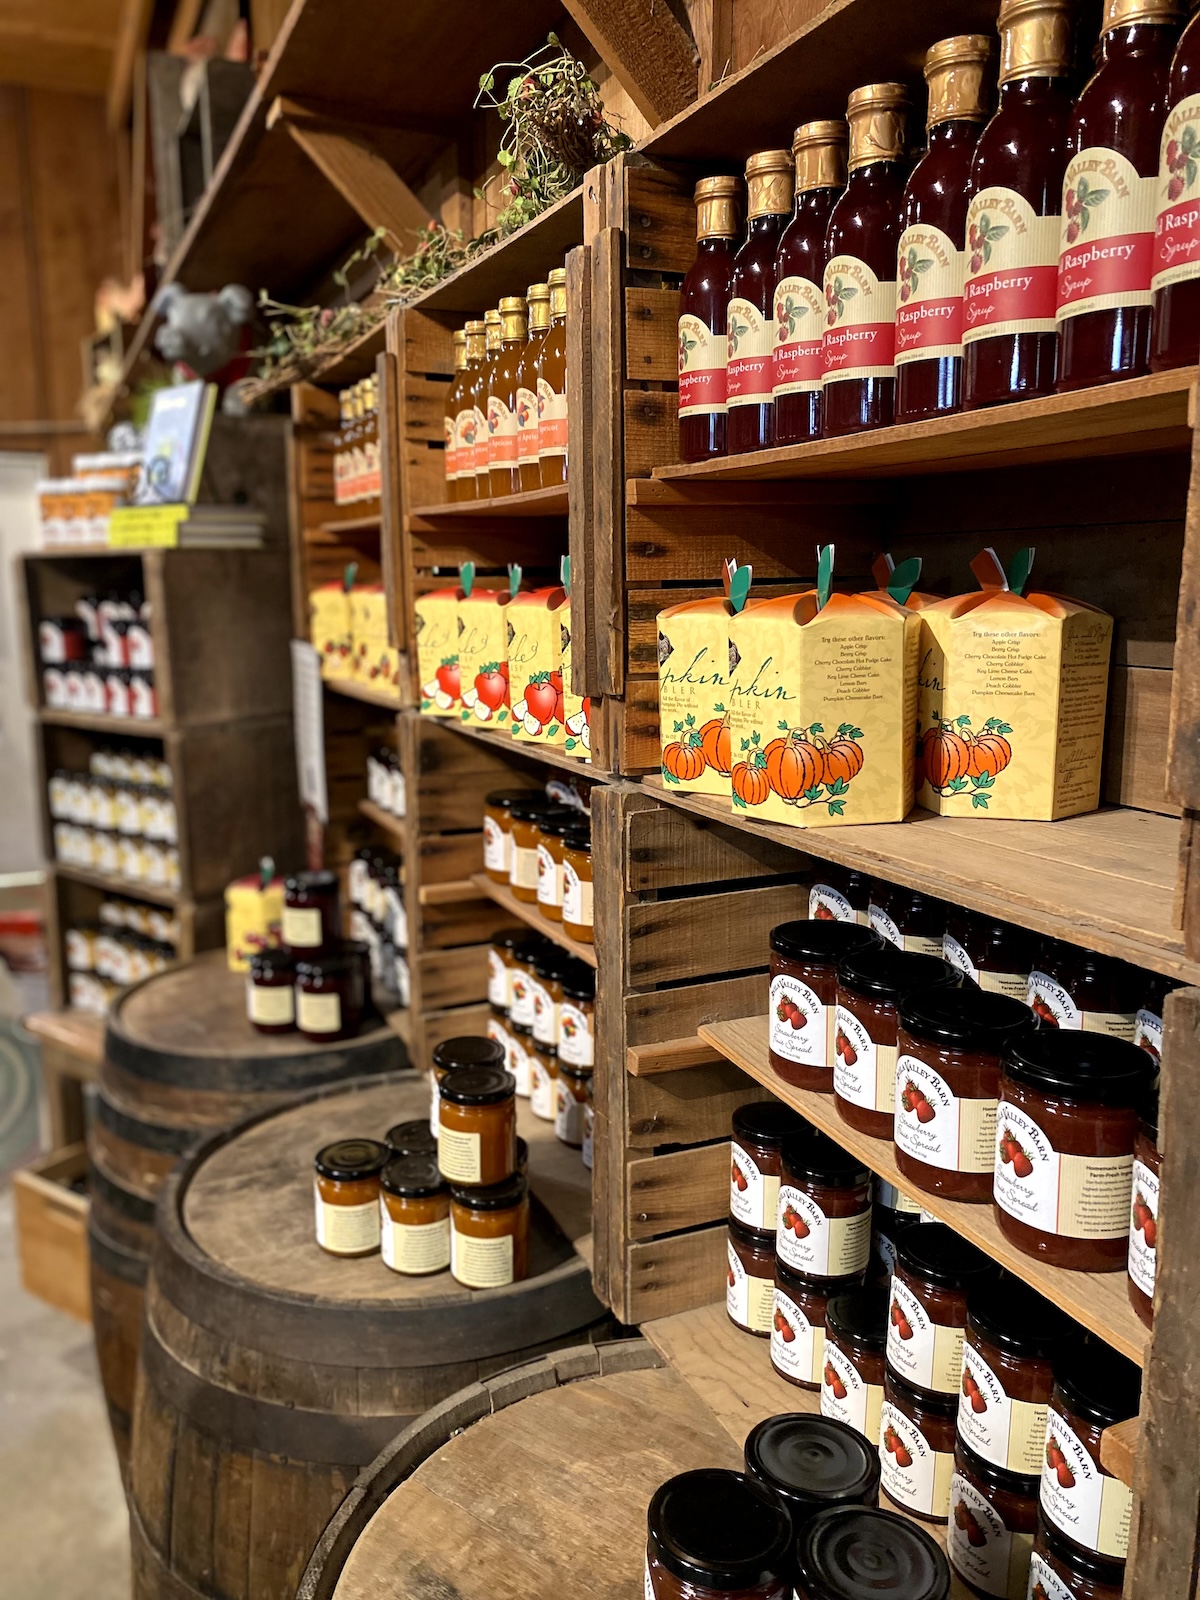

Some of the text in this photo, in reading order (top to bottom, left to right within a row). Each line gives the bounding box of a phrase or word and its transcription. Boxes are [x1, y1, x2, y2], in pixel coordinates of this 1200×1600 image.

[1066, 158, 1130, 199] VALLEY BARN
[969, 197, 1027, 235] VALLEY BARN
[925, 234, 950, 268] BARN
[1064, 244, 1136, 268] Raspberry
[1160, 236, 1200, 263] Syrup
[850, 265, 872, 297] BARN
[969, 276, 1033, 298] Raspberry
[1060, 274, 1092, 299] Syrup
[801, 285, 822, 315] BARN
[966, 302, 996, 324] Syrup
[899, 305, 955, 323] Raspberry
[826, 330, 877, 347] Raspberry
[897, 329, 922, 347] Syrup
[778, 346, 822, 361] Raspberr
[825, 350, 848, 367] Syrup
[777, 364, 799, 380] Syrup
[660, 647, 729, 690] pkin
[730, 656, 797, 704] pkin
[663, 686, 696, 695] BLER
[731, 699, 761, 710] BLER
[835, 895, 850, 918] BARN
[884, 917, 898, 943] BARN
[779, 977, 820, 1014] VALLEY BARN
[1055, 989, 1074, 1020] BARN
[774, 1023, 809, 1045] Strawberry
[785, 1038, 813, 1055] Spread
[853, 1023, 870, 1052] BARN
[904, 1059, 951, 1107] VALLEY BARN
[899, 1112, 937, 1141] Strawberry
[909, 1133, 941, 1153] Spread
[1028, 1127, 1049, 1162] BARN
[1006, 1188, 1039, 1212] Spread
[806, 1202, 823, 1226] BARN
[789, 1247, 815, 1262] Spread
[910, 1301, 927, 1330] BARN
[844, 1363, 860, 1390] BARN
[984, 1371, 1002, 1404] BARN
[909, 1428, 927, 1458] BARN
[1073, 1443, 1093, 1481] BARN
[888, 1474, 918, 1496] Spread
[983, 1506, 1002, 1538] BARN
